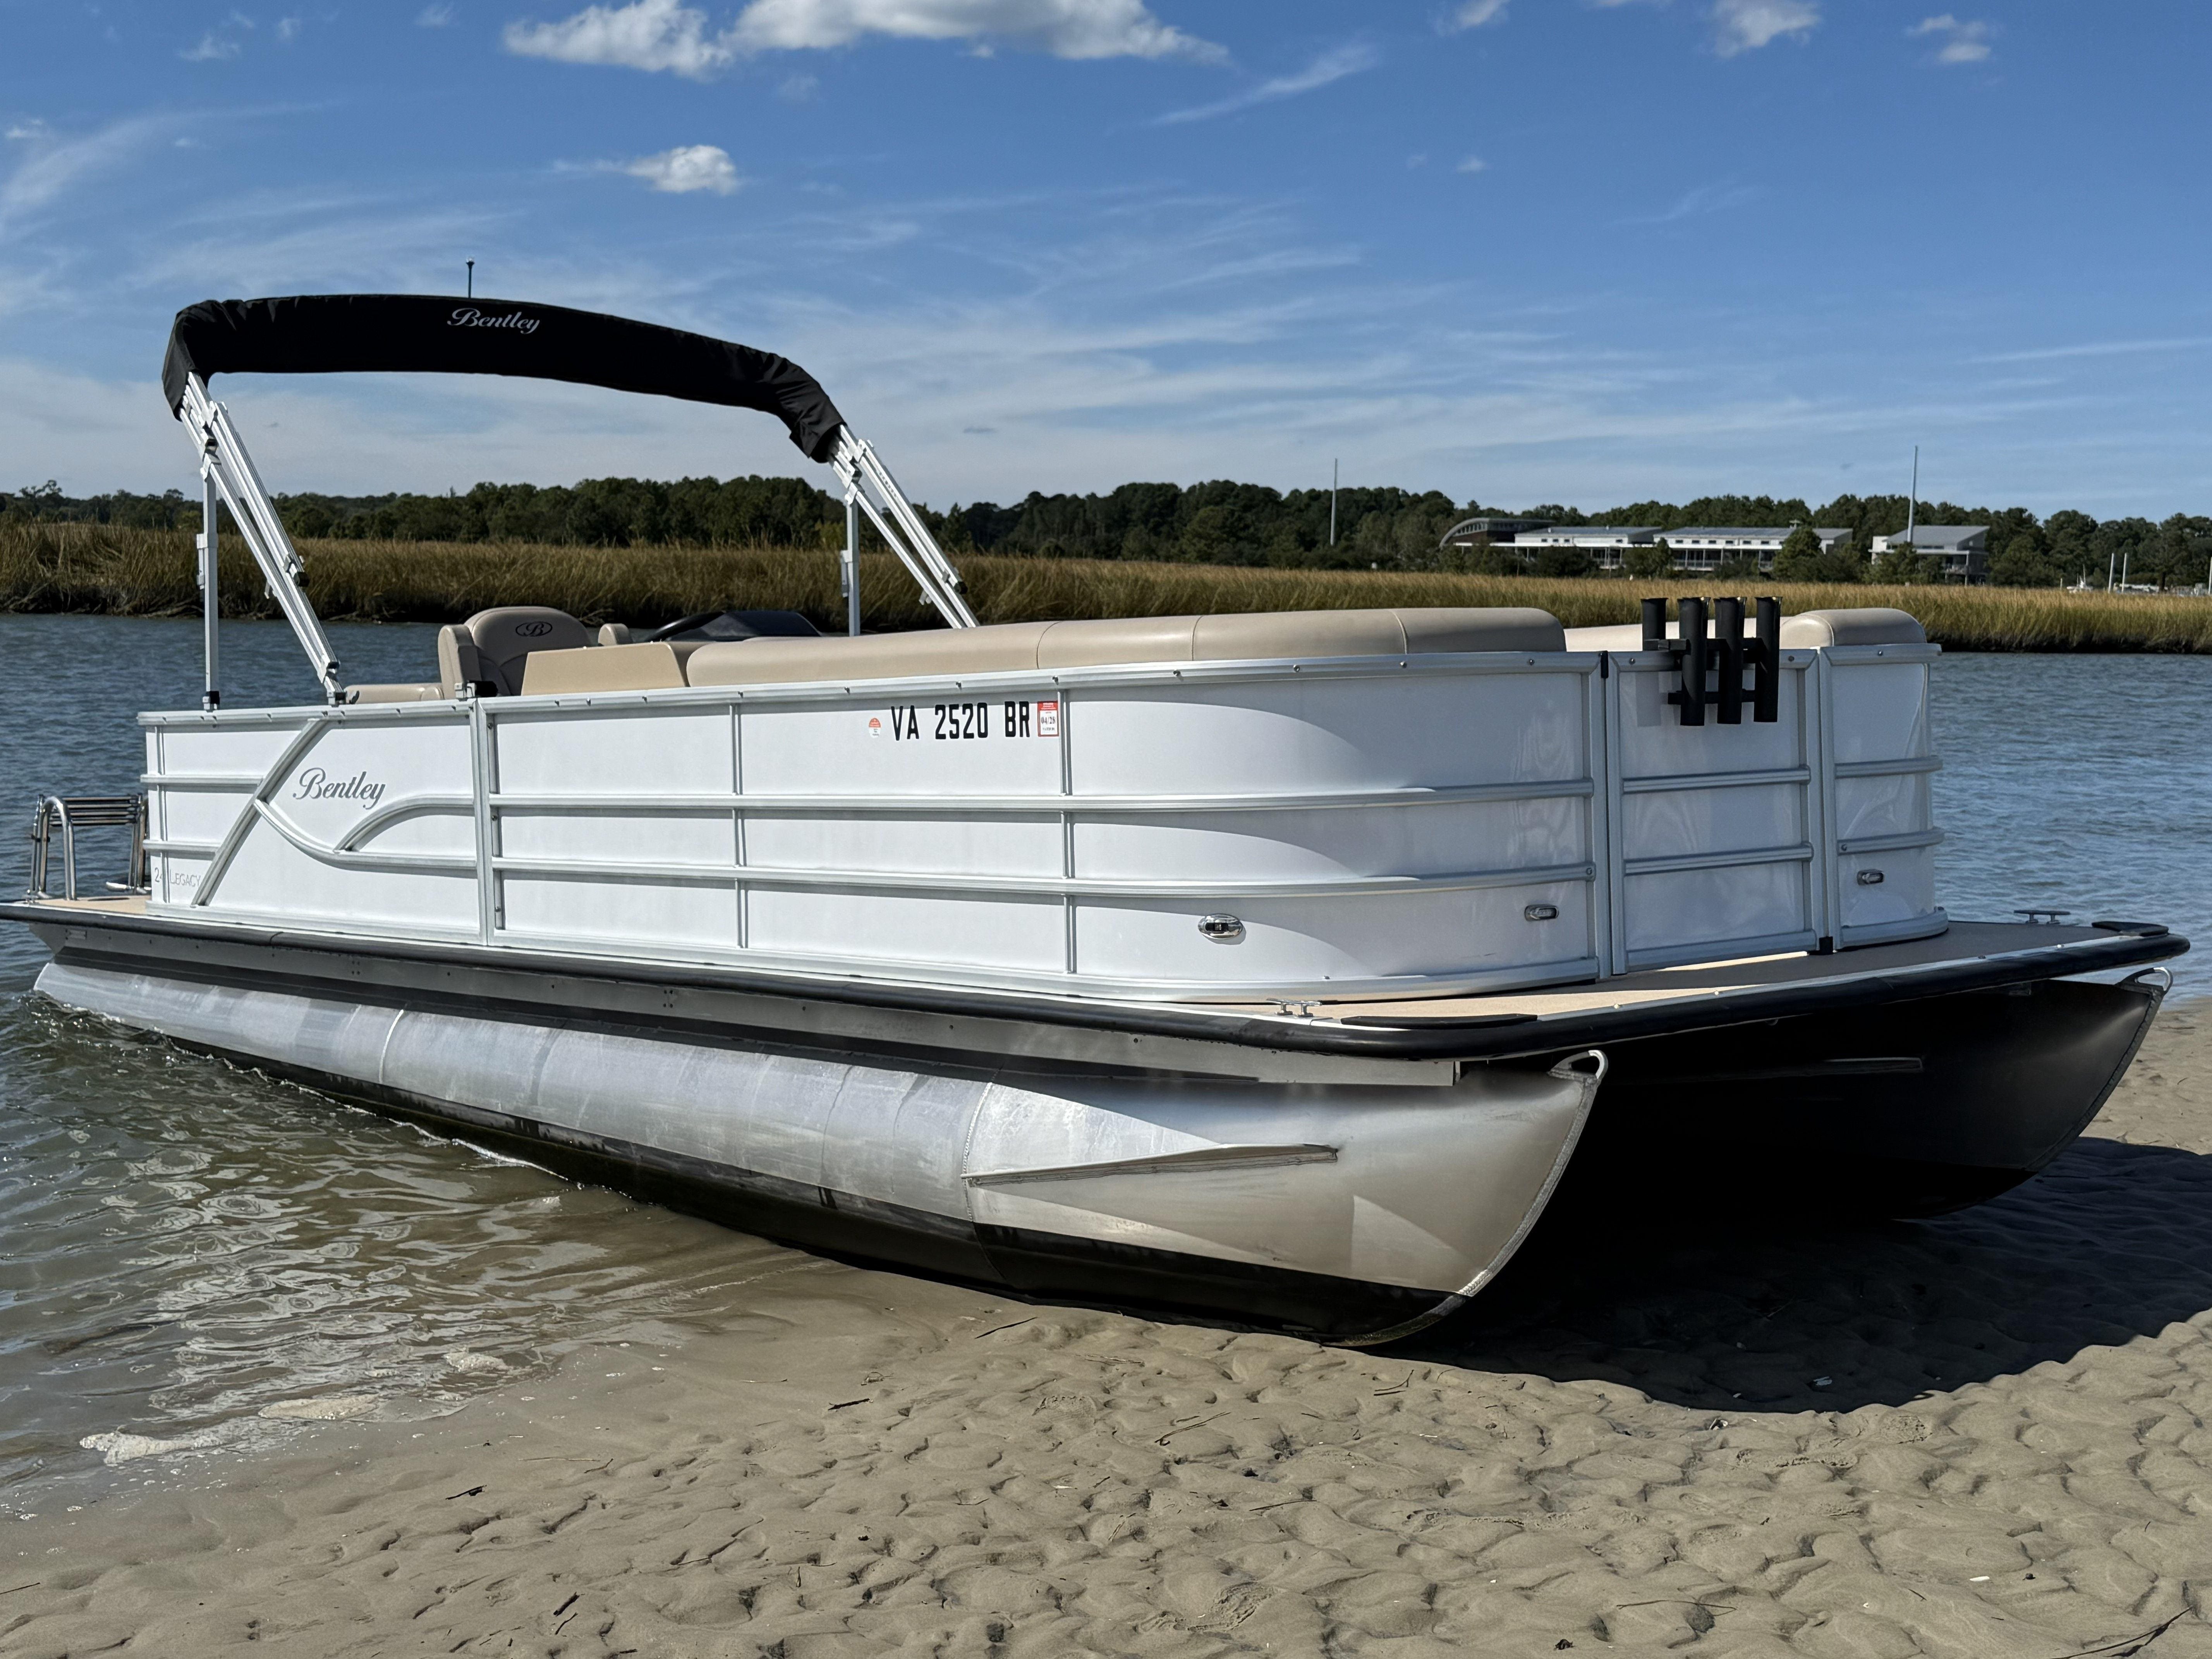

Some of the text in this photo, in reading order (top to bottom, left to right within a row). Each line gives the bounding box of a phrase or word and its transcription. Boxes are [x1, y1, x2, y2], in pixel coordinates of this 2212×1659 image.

[447, 308, 540, 334] Bentley
[891, 701, 1030, 741] VA 2520 BR
[292, 768, 386, 810] Bentley
[155, 867, 201, 887] 2 LEGACY
